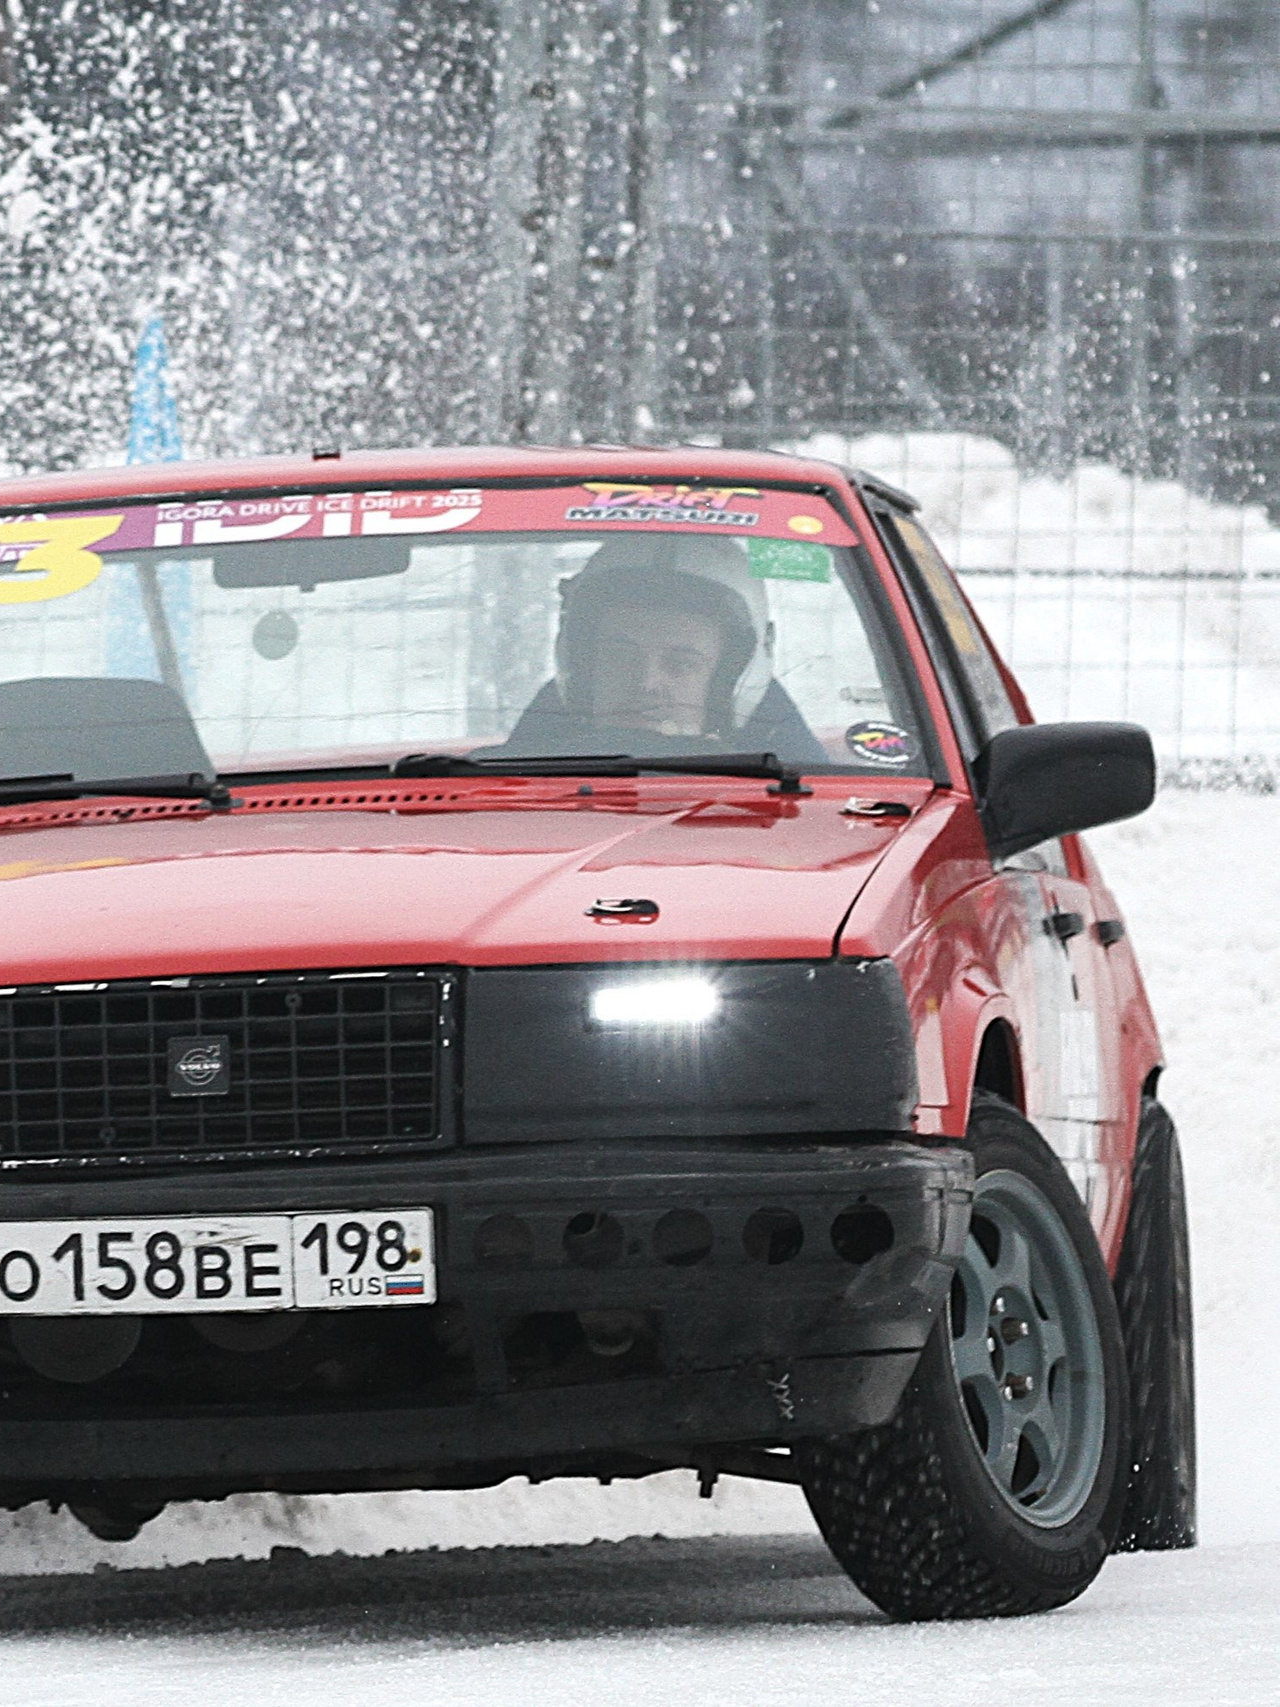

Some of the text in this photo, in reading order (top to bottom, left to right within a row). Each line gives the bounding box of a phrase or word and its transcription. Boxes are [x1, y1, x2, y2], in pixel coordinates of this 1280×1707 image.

[157, 492, 483, 522] IGORA DRIVE ICE DRIFT 2025
[300, 1220, 408, 1275] 198
[328, 1276, 382, 1297] RUS
